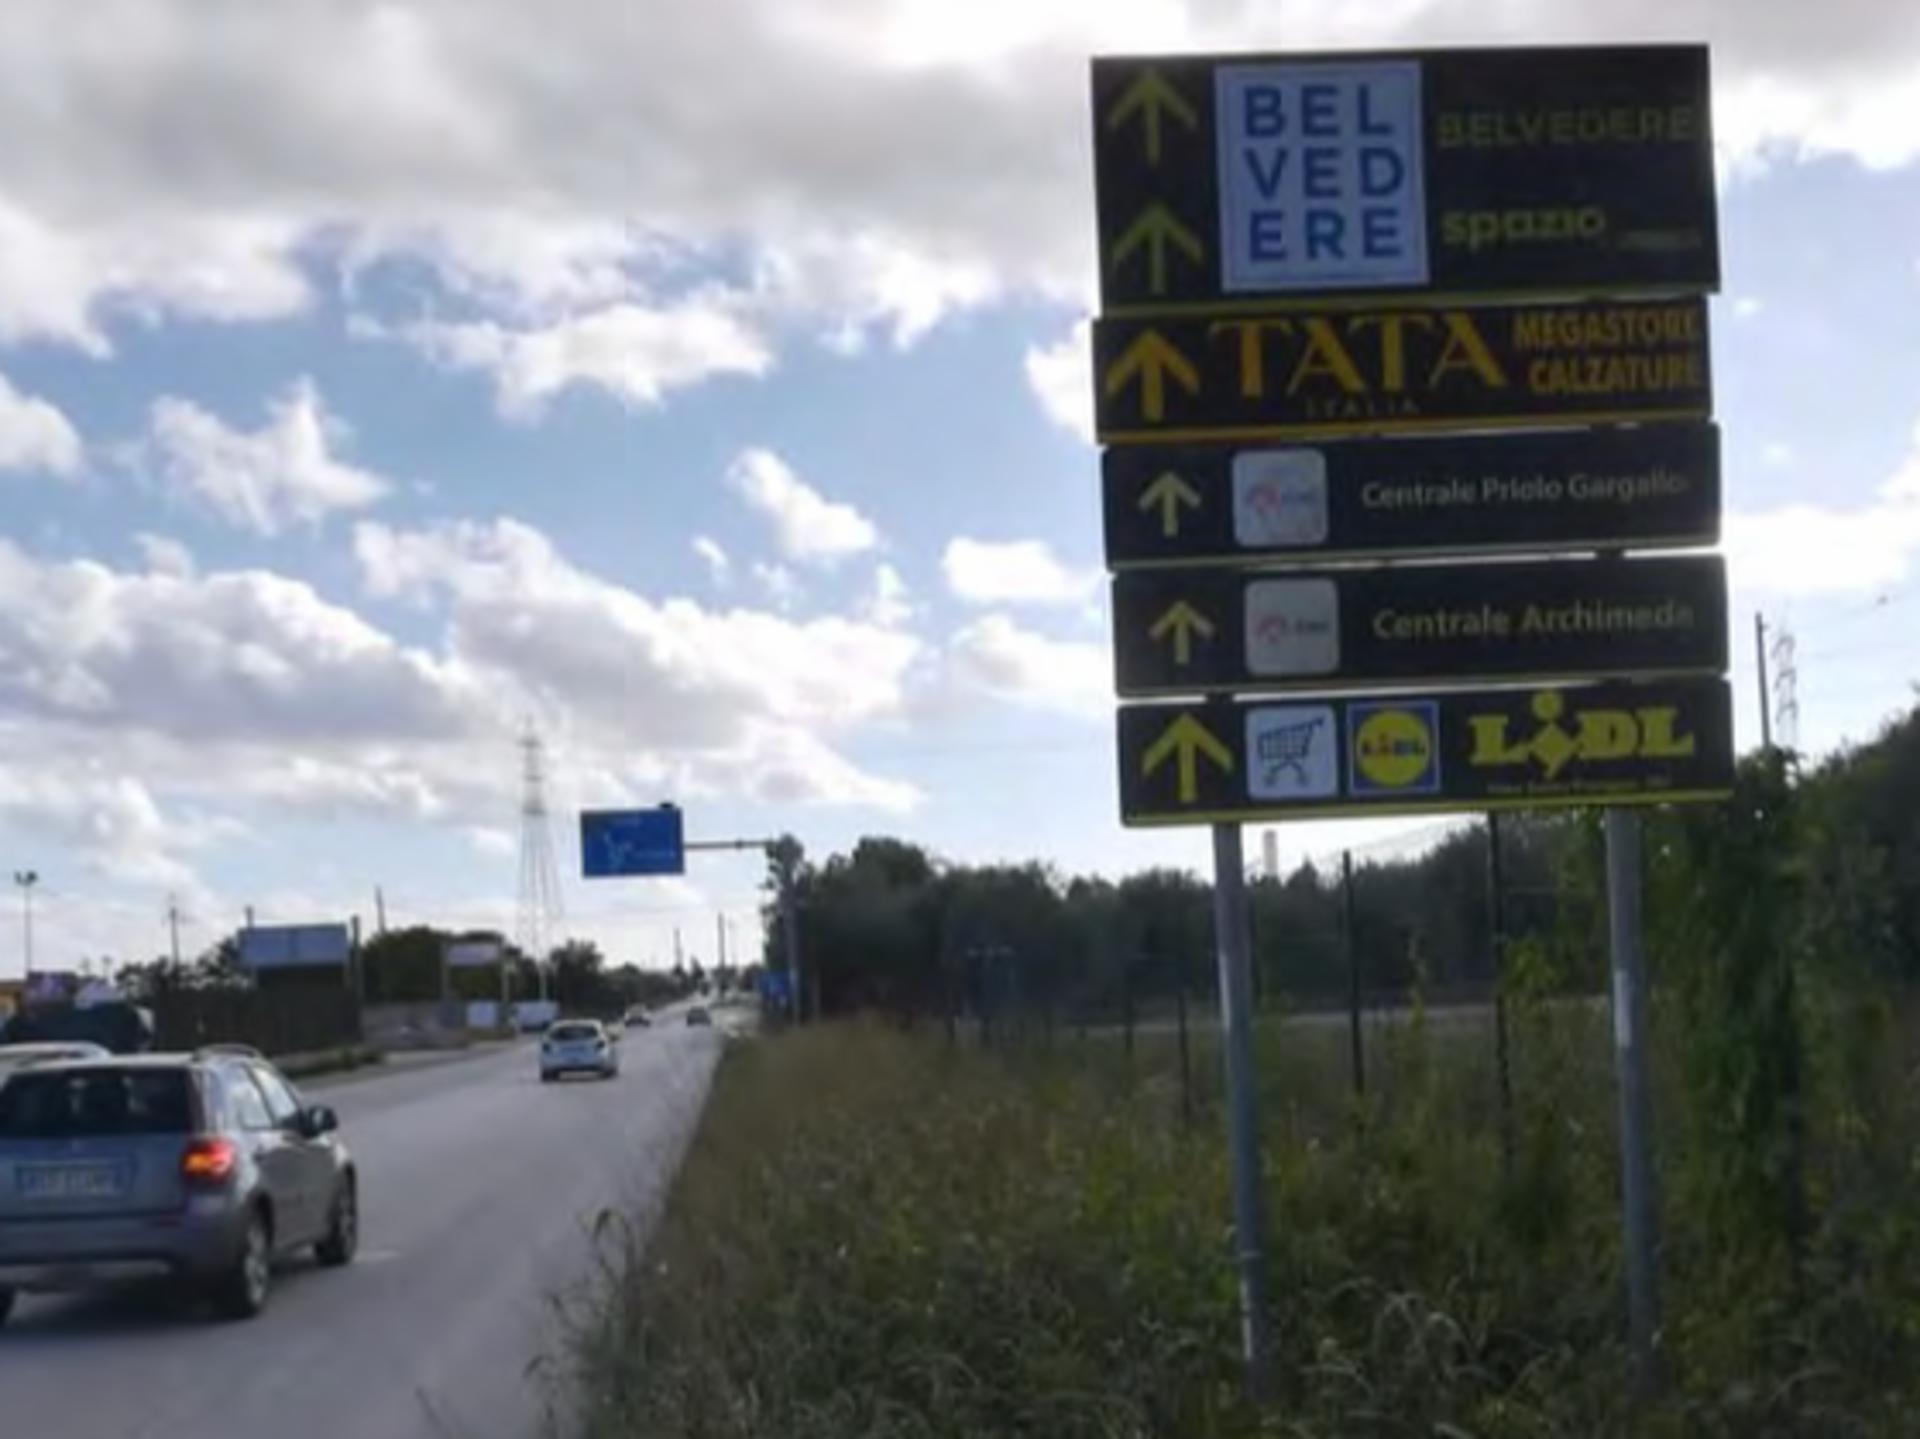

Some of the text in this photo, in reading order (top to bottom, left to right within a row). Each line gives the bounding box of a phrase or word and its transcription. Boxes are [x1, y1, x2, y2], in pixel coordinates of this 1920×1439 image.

[1242, 83, 1394, 138] BEL
[1435, 106, 1694, 148] BELVEDERE
[1244, 147, 1405, 198] VED
[1249, 208, 1402, 262] ERE
[1441, 206, 1606, 252] spazio
[1208, 310, 1509, 399] TATA
[1361, 469, 1684, 509] Centrale Priolo Gargallo
[1372, 599, 1694, 640] Centrale Archimede
